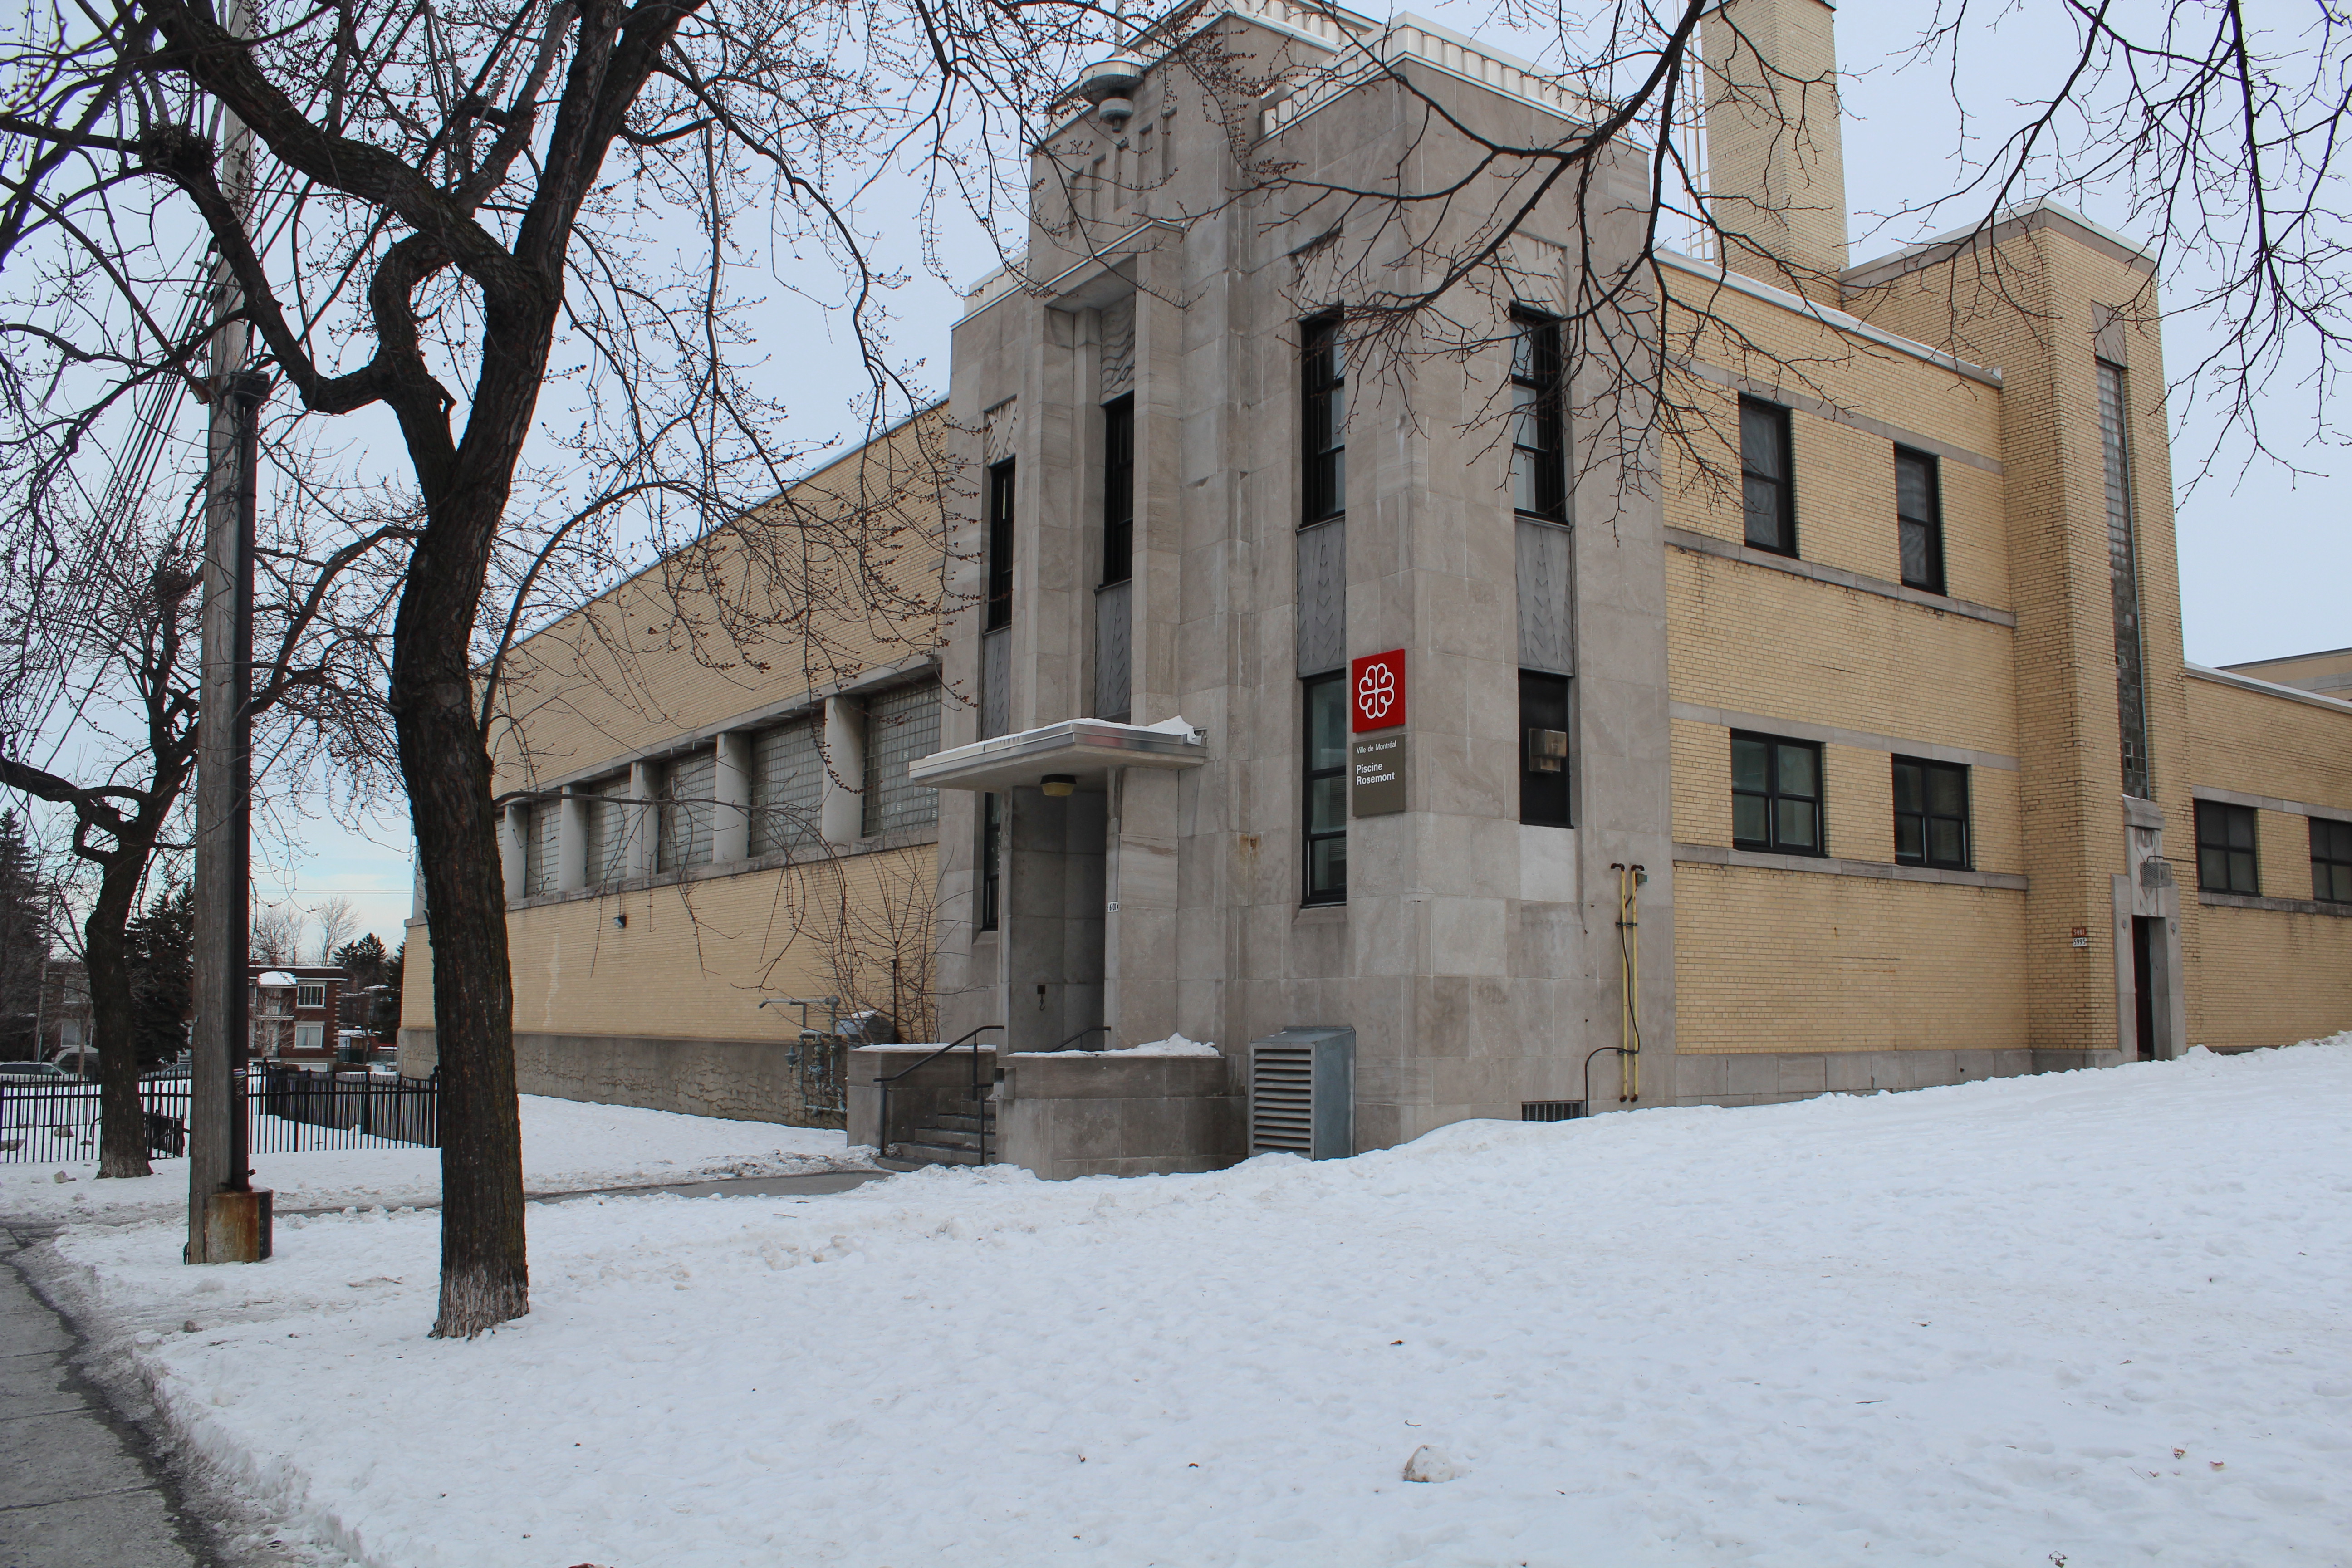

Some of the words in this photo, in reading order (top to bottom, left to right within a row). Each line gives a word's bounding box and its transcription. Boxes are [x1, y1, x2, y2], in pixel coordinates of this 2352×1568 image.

[1375, 740, 1396, 750] Montréal
[1357, 762, 1383, 774] Piscine
[1357, 771, 1395, 785] Rosemont
